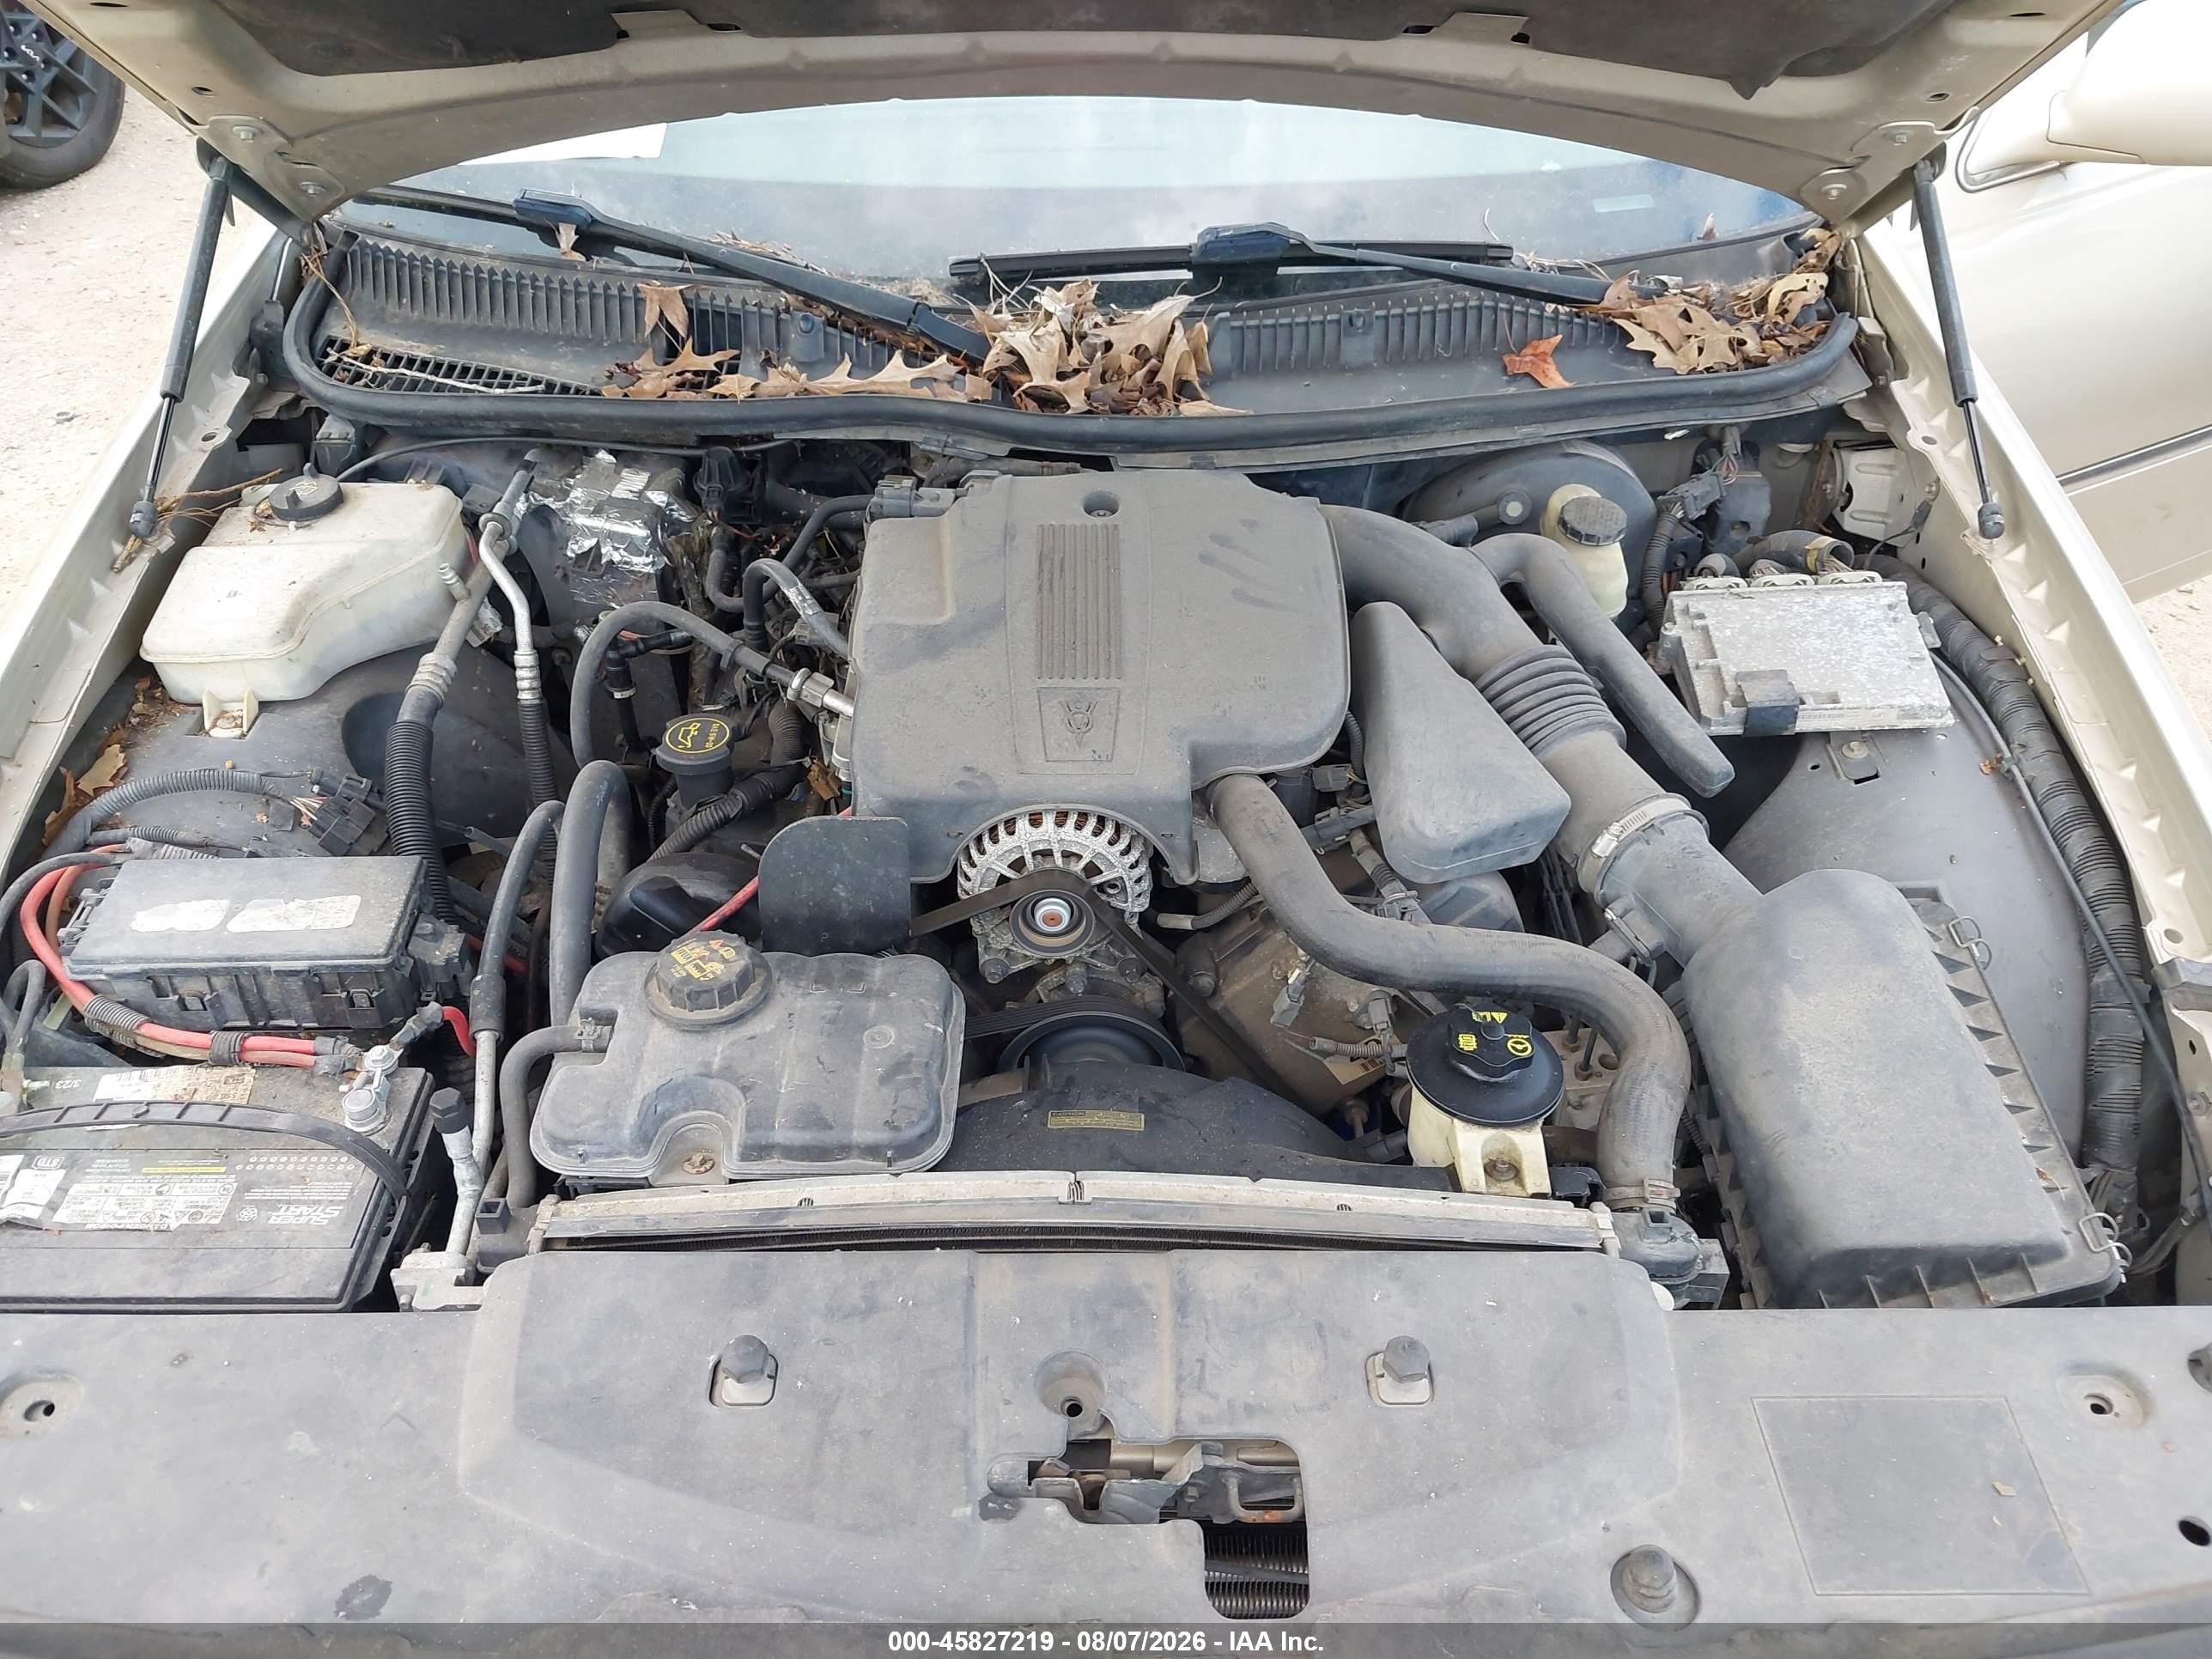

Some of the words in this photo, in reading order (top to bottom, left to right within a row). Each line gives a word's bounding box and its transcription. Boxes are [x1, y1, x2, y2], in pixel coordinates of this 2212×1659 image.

[55, 1079, 82, 1090] 3/23
[271, 1206, 344, 1218] START
[267, 1215, 330, 1225] SUPER
